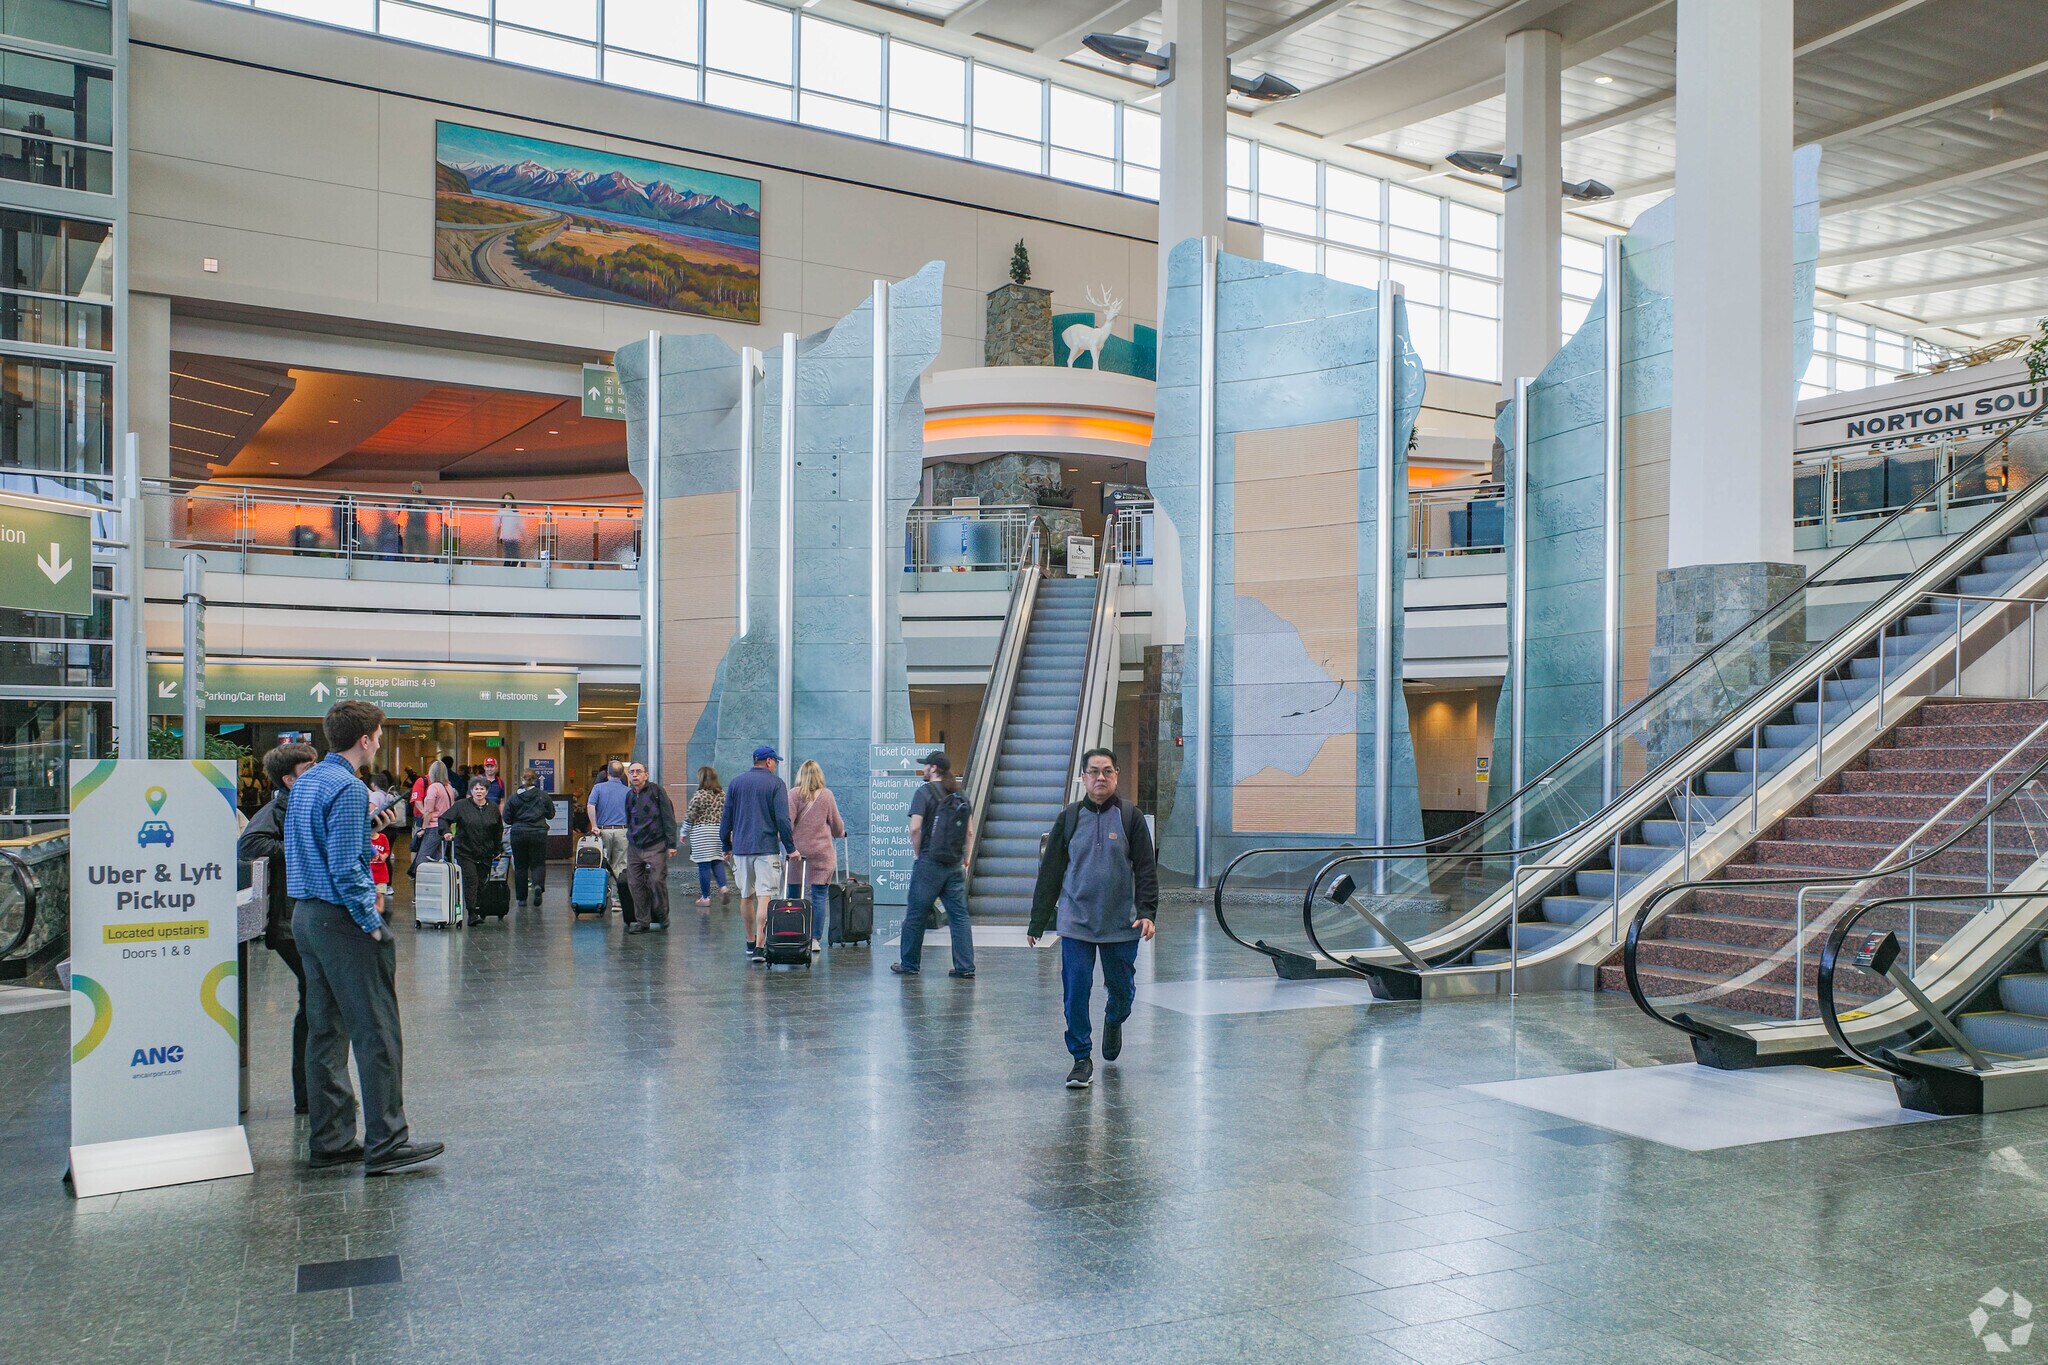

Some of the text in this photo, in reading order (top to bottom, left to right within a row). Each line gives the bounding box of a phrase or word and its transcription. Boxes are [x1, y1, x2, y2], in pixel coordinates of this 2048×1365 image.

[1847, 402, 1964, 439] NORTON
[353, 676, 436, 688] Baggage Claims 4-9
[258, 692, 286, 702] Rental
[369, 689, 389, 697] Gates
[496, 691, 538, 701] Restrooms
[380, 700, 428, 709] Transportation
[874, 746, 899, 757] Ticket
[871, 779, 902, 788] Aleutian
[871, 790, 899, 799] Condor
[871, 813, 889, 822] Delta
[871, 824, 903, 833] Discover
[871, 836, 889, 845] Ravn
[871, 847, 886, 856] Sun
[871, 859, 895, 868] United
[88, 861, 222, 886] Uber & Lyft
[116, 891, 196, 912] Pickup
[107, 923, 206, 941] Located upstairs
[122, 945, 191, 960] Doors 1 & 8
[130, 1045, 184, 1067] ANC
